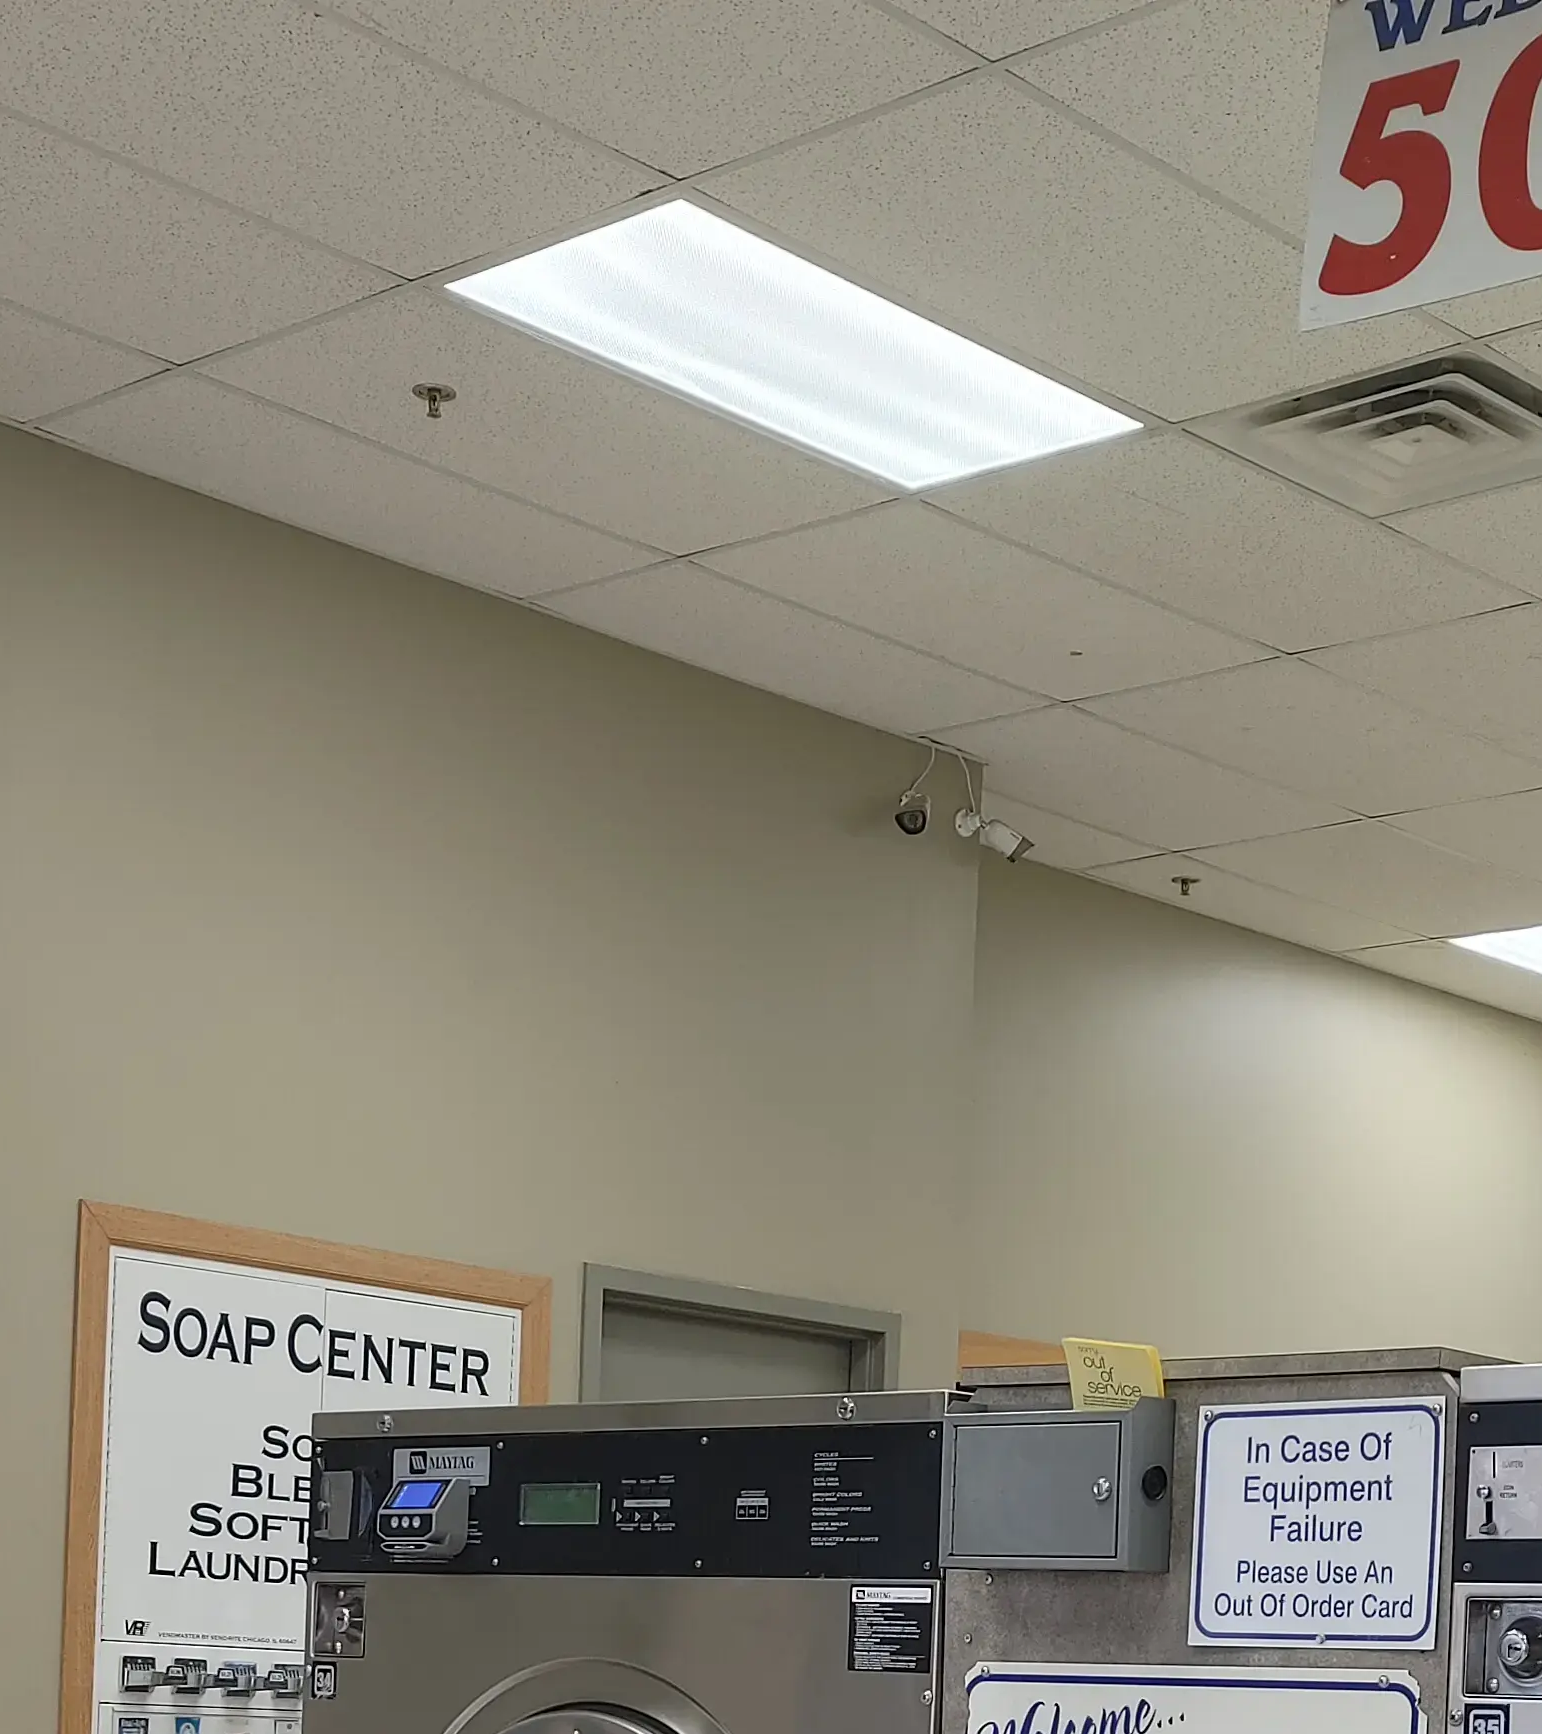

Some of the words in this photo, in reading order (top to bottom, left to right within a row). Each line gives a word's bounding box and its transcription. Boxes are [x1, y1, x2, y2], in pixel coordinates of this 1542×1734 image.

[137, 1292, 275, 1366] SOAP
[287, 1314, 490, 1398] CENTER
[1084, 1356, 1105, 1369] out
[1101, 1367, 1113, 1382] of
[1088, 1382, 1141, 1397] service
[1247, 1436, 1270, 1464] In
[1280, 1435, 1350, 1462] Case
[1360, 1432, 1393, 1461] Of
[429, 1455, 475, 1470] MAYTAG
[1244, 1474, 1393, 1510] Equipment
[1270, 1514, 1362, 1542] Failure
[1237, 1559, 1307, 1584] Please
[1316, 1559, 1357, 1584] Use
[1364, 1559, 1393, 1584] An
[1215, 1594, 1252, 1616] Out
[1262, 1594, 1286, 1617] Of
[1292, 1594, 1354, 1618] Order
[1361, 1594, 1413, 1619] Card
[317, 1672, 331, 1689] 34
